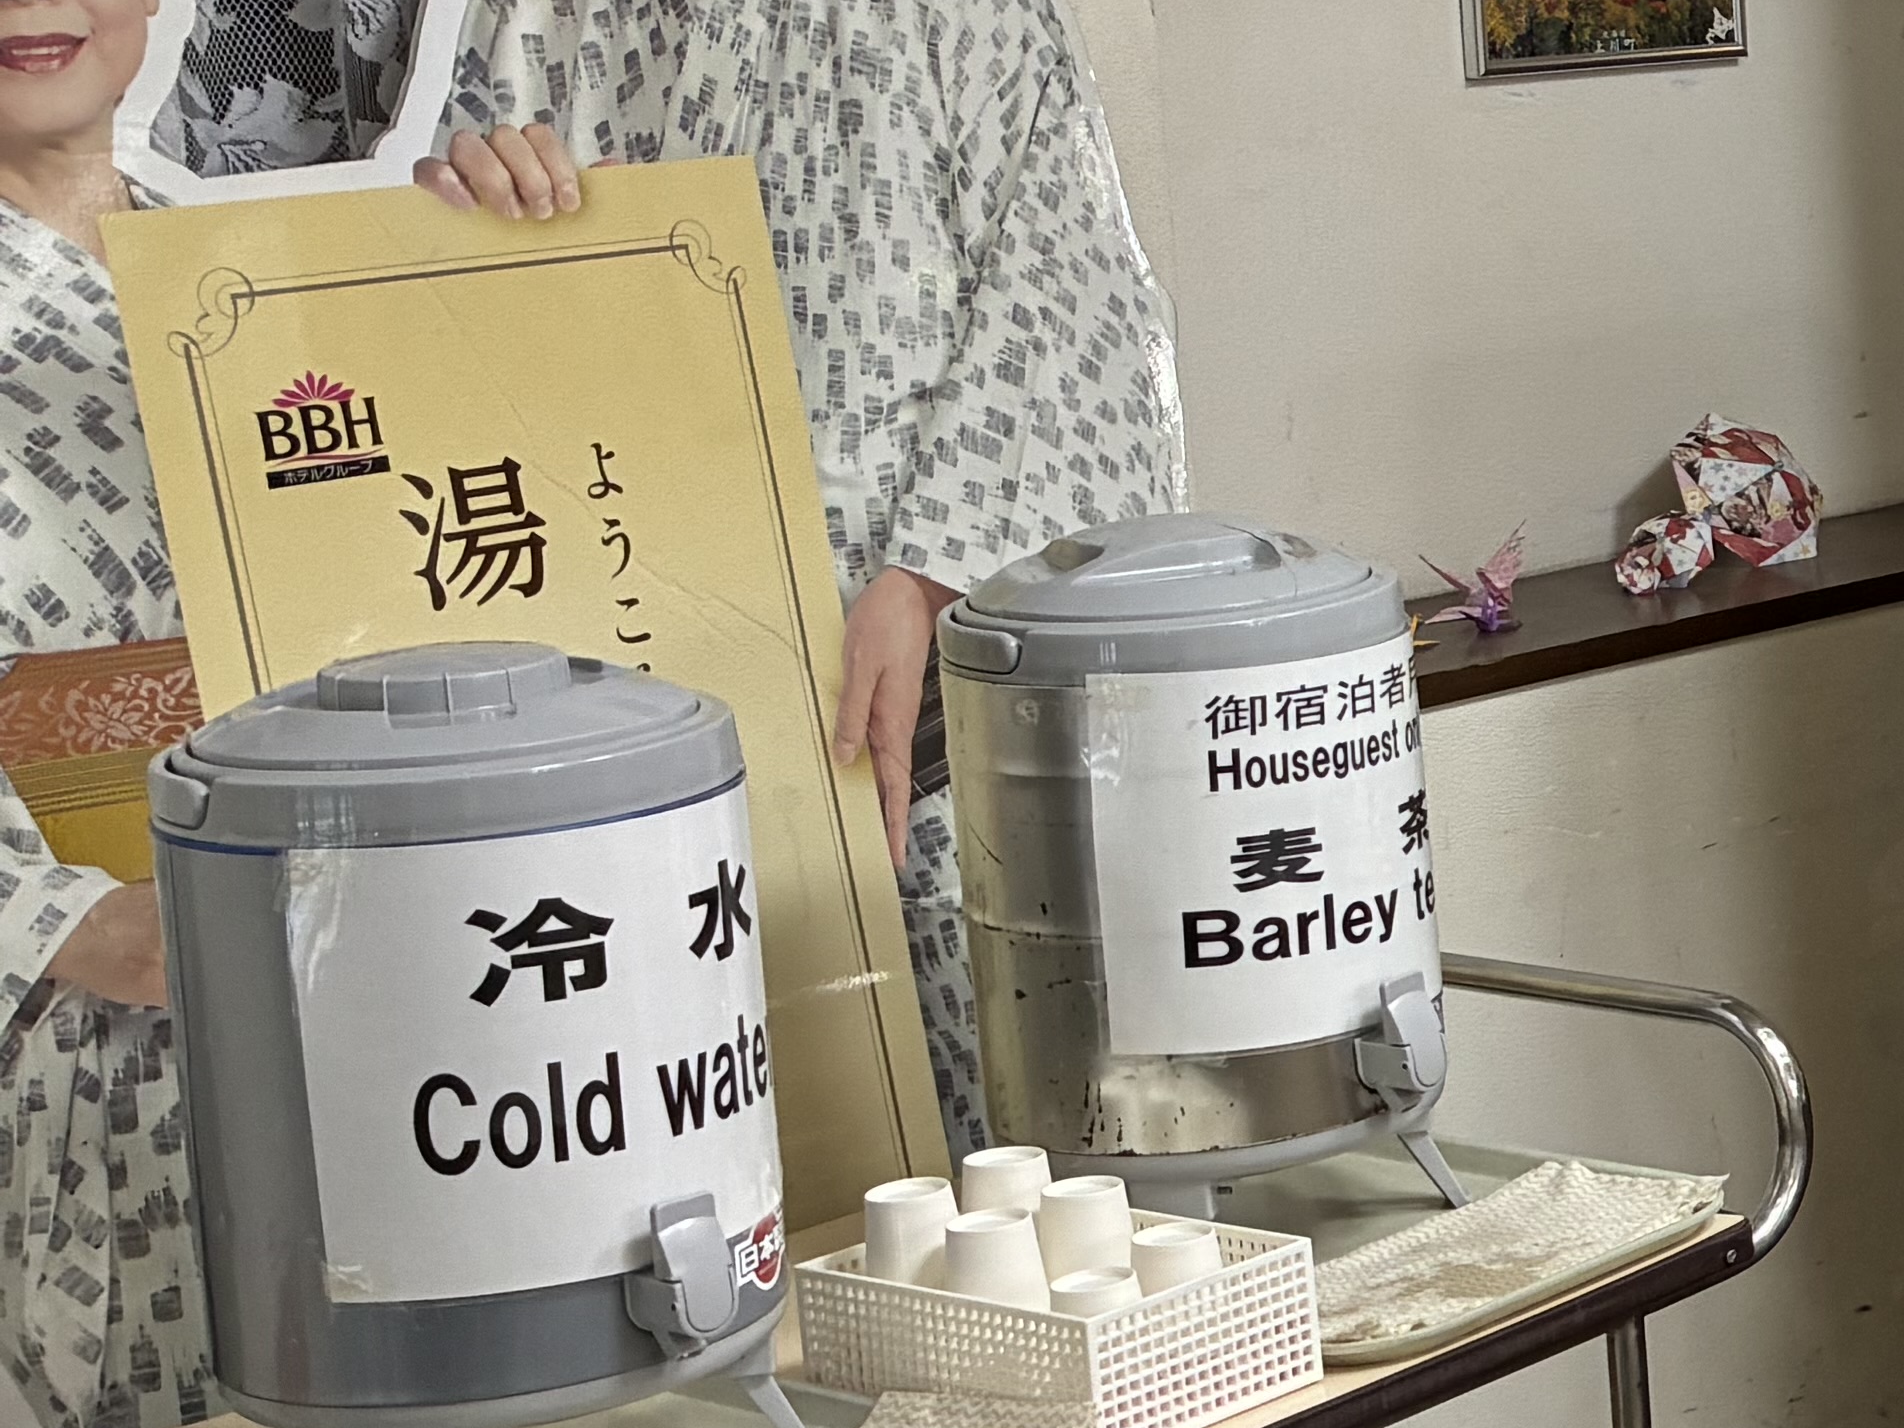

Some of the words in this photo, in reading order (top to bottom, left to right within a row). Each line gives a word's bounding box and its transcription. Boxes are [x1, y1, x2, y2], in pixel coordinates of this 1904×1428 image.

[255, 396, 384, 461] BBH
[283, 460, 373, 484] ホテルグループ
[398, 456, 547, 611] 湯
[587, 442, 652, 673] ようこ
[1208, 728, 1399, 793] Houseguest
[1182, 887, 1398, 969] Barley
[1413, 866, 1435, 921] te
[413, 1051, 626, 1176] Cold
[657, 1013, 775, 1138] wate
